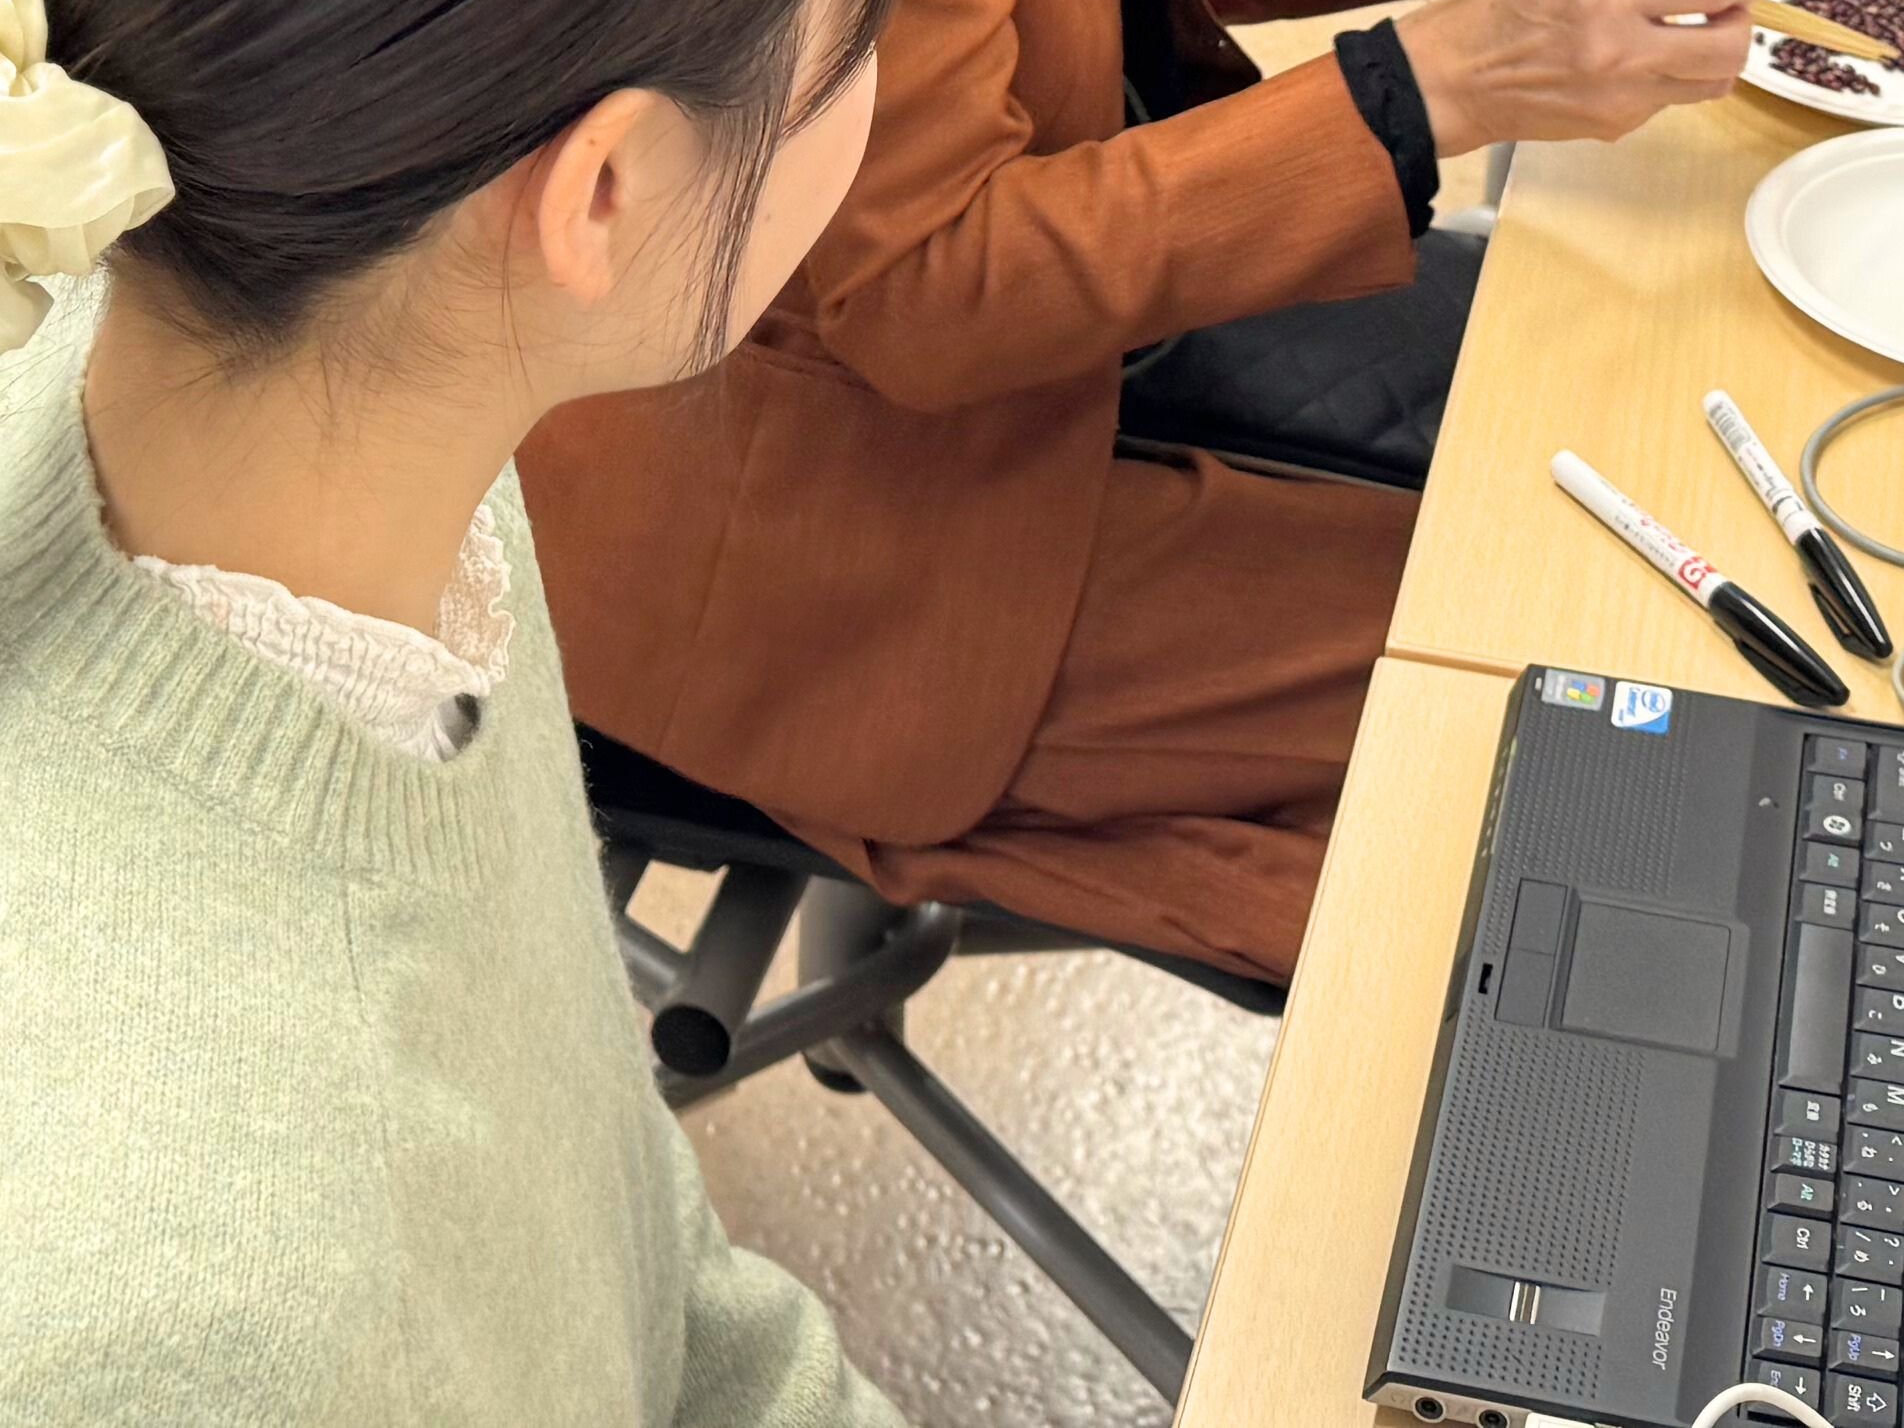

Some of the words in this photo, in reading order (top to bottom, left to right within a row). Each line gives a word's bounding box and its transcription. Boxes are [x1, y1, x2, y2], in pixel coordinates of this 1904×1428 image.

[1797, 1228, 1811, 1249] Ctrl
[1652, 1287, 1678, 1371] Endeavor
[1848, 1385, 1862, 1413] Shift
